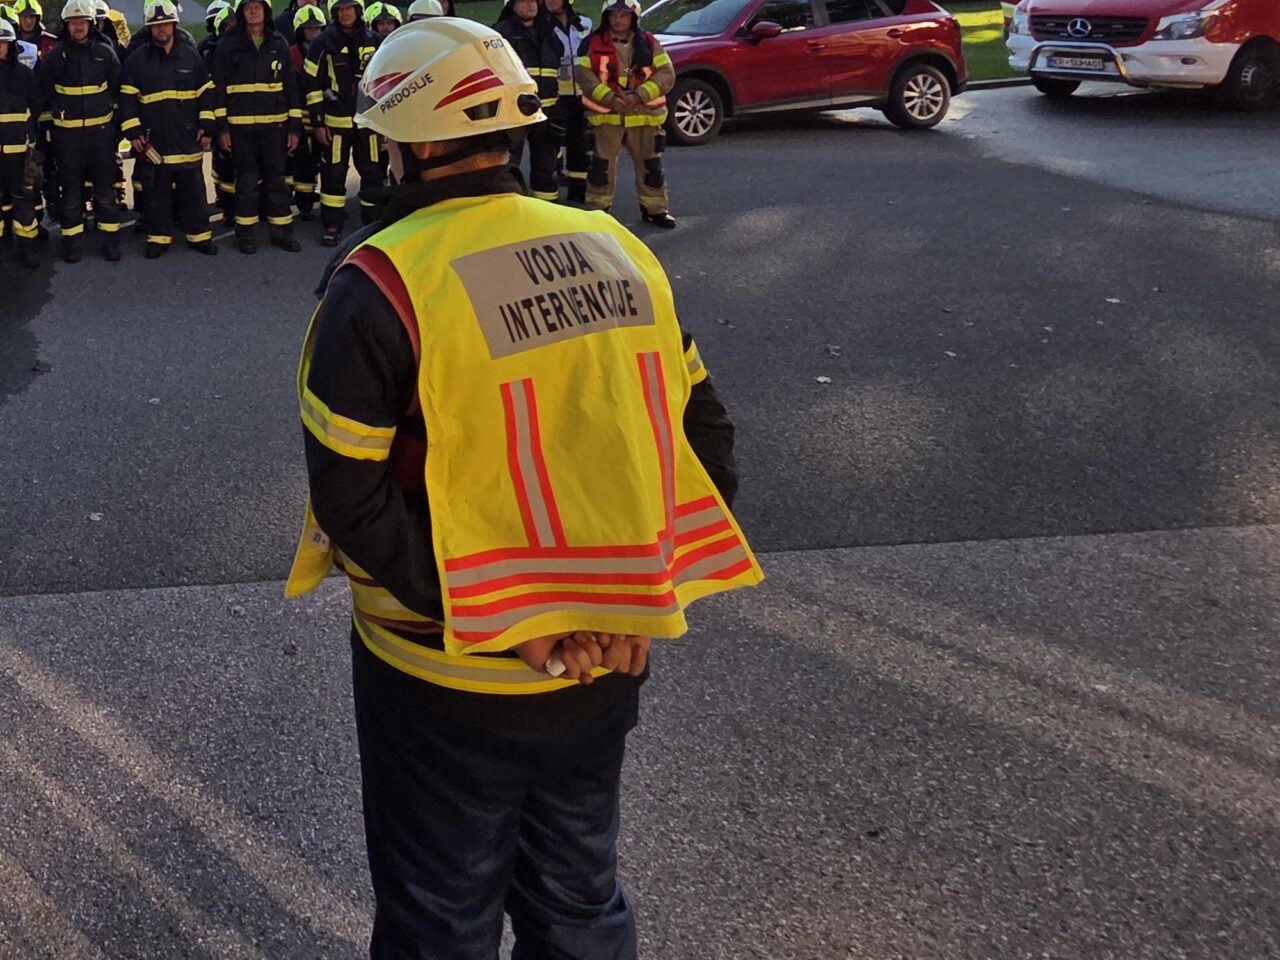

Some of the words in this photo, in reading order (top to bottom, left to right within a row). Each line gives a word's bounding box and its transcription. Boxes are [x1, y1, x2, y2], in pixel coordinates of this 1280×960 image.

[483, 38, 505, 51] PGD
[379, 73, 435, 114] PREDOSLJE
[515, 240, 595, 286] VODJA
[498, 280, 639, 344] INTERVENCIJE
